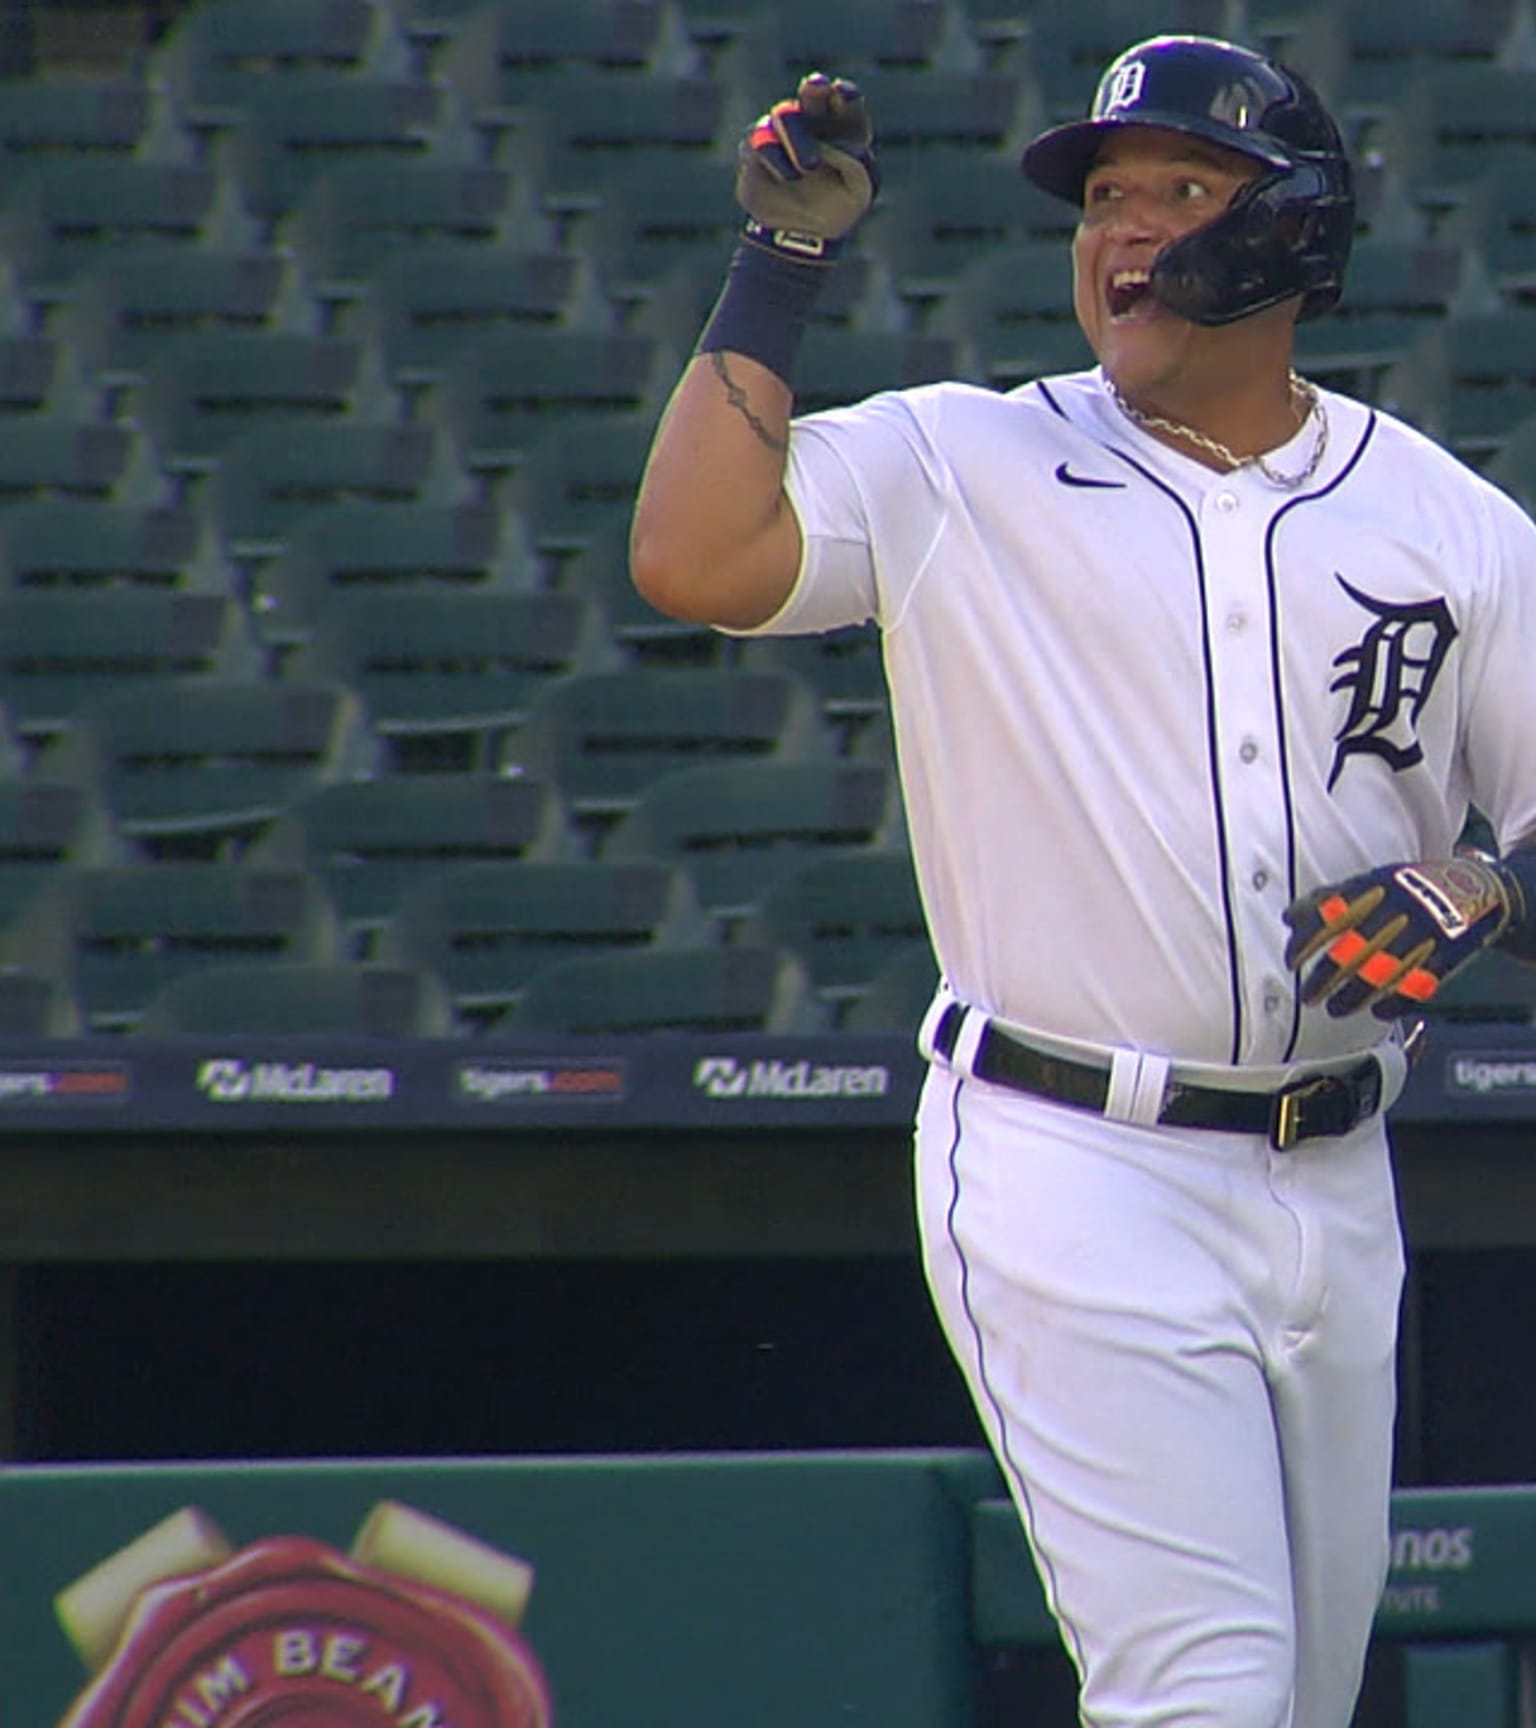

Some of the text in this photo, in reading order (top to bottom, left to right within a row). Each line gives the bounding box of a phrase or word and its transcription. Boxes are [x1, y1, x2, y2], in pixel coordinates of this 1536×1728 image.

[1326, 571, 1459, 794] D
[250, 1063, 393, 1099] McLaren
[460, 1068, 621, 1098] tigers.com
[748, 1060, 889, 1095] McLaren
